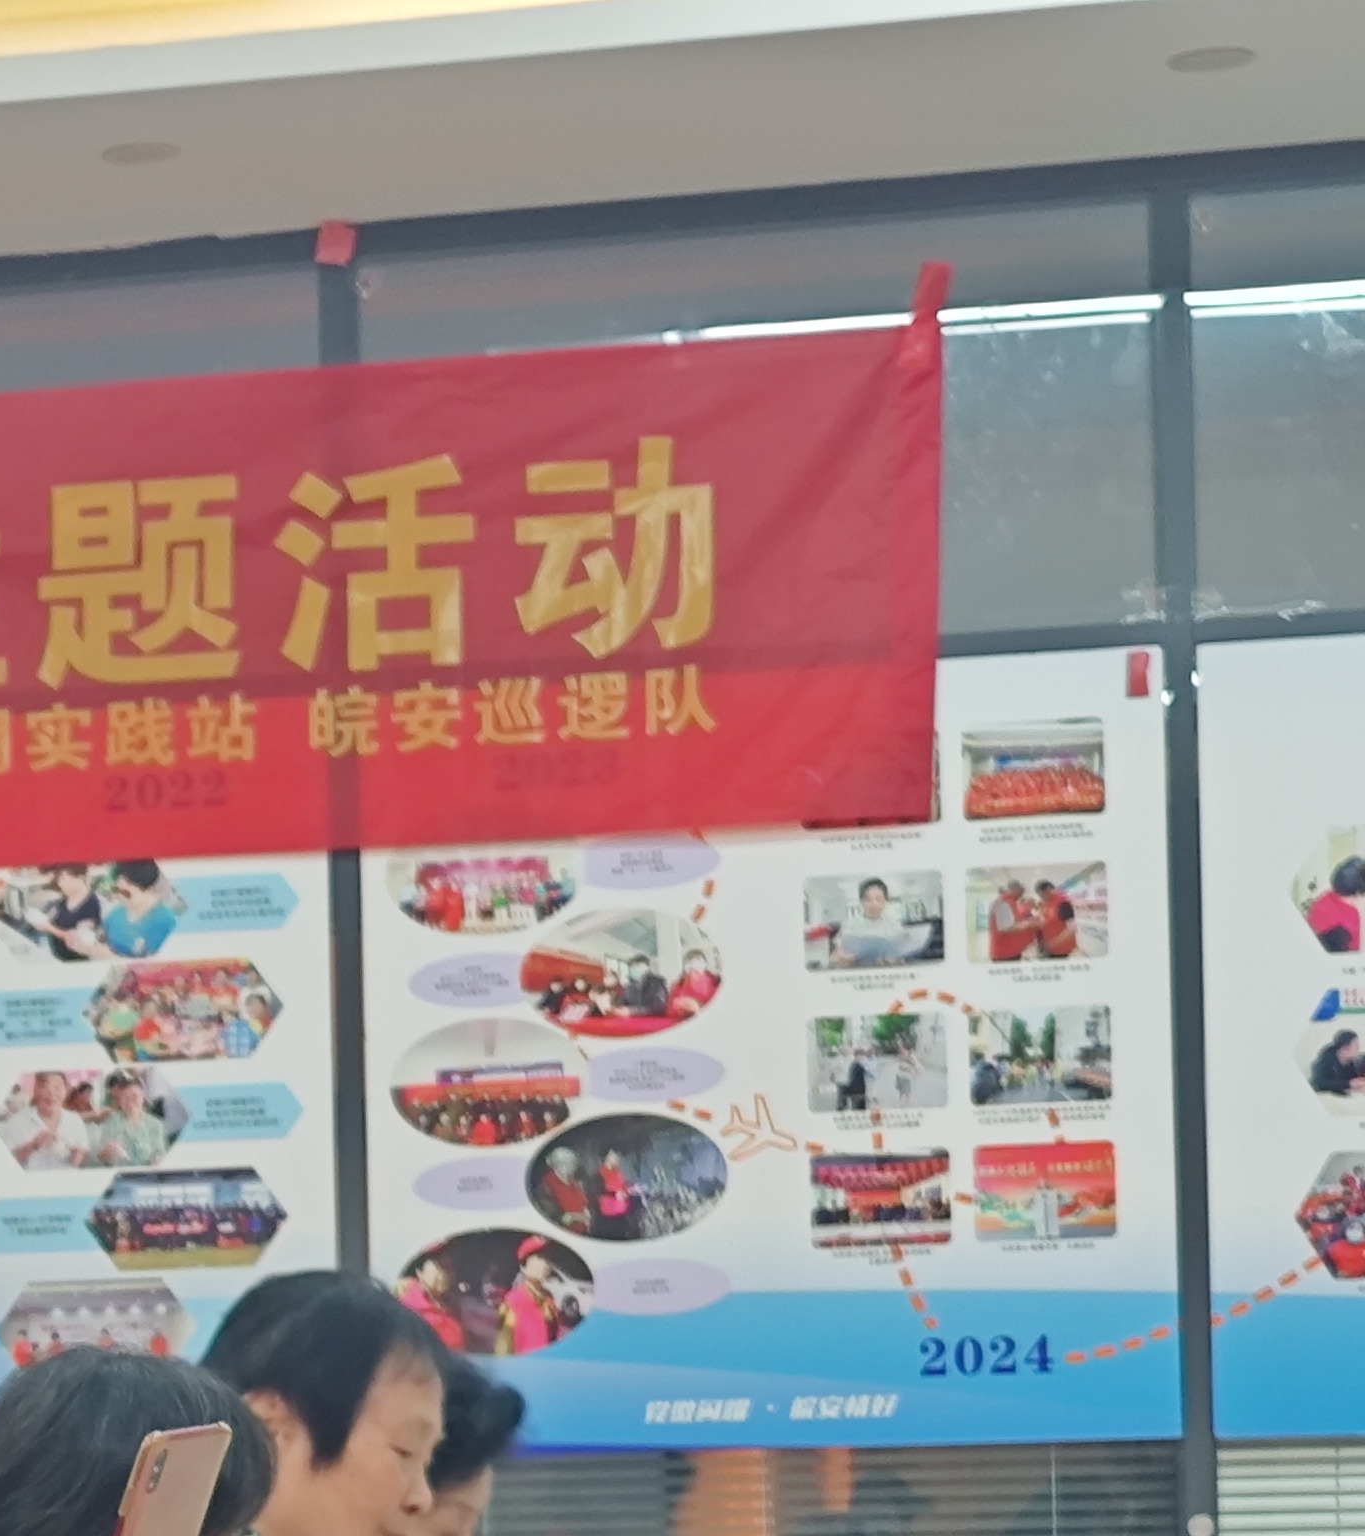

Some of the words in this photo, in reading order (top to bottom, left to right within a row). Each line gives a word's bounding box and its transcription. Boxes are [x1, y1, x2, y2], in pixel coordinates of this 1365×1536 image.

[309, 665, 716, 756] 皖安巡逻队
[103, 767, 226, 814] 2022
[919, 1334, 1054, 1377] 2024
